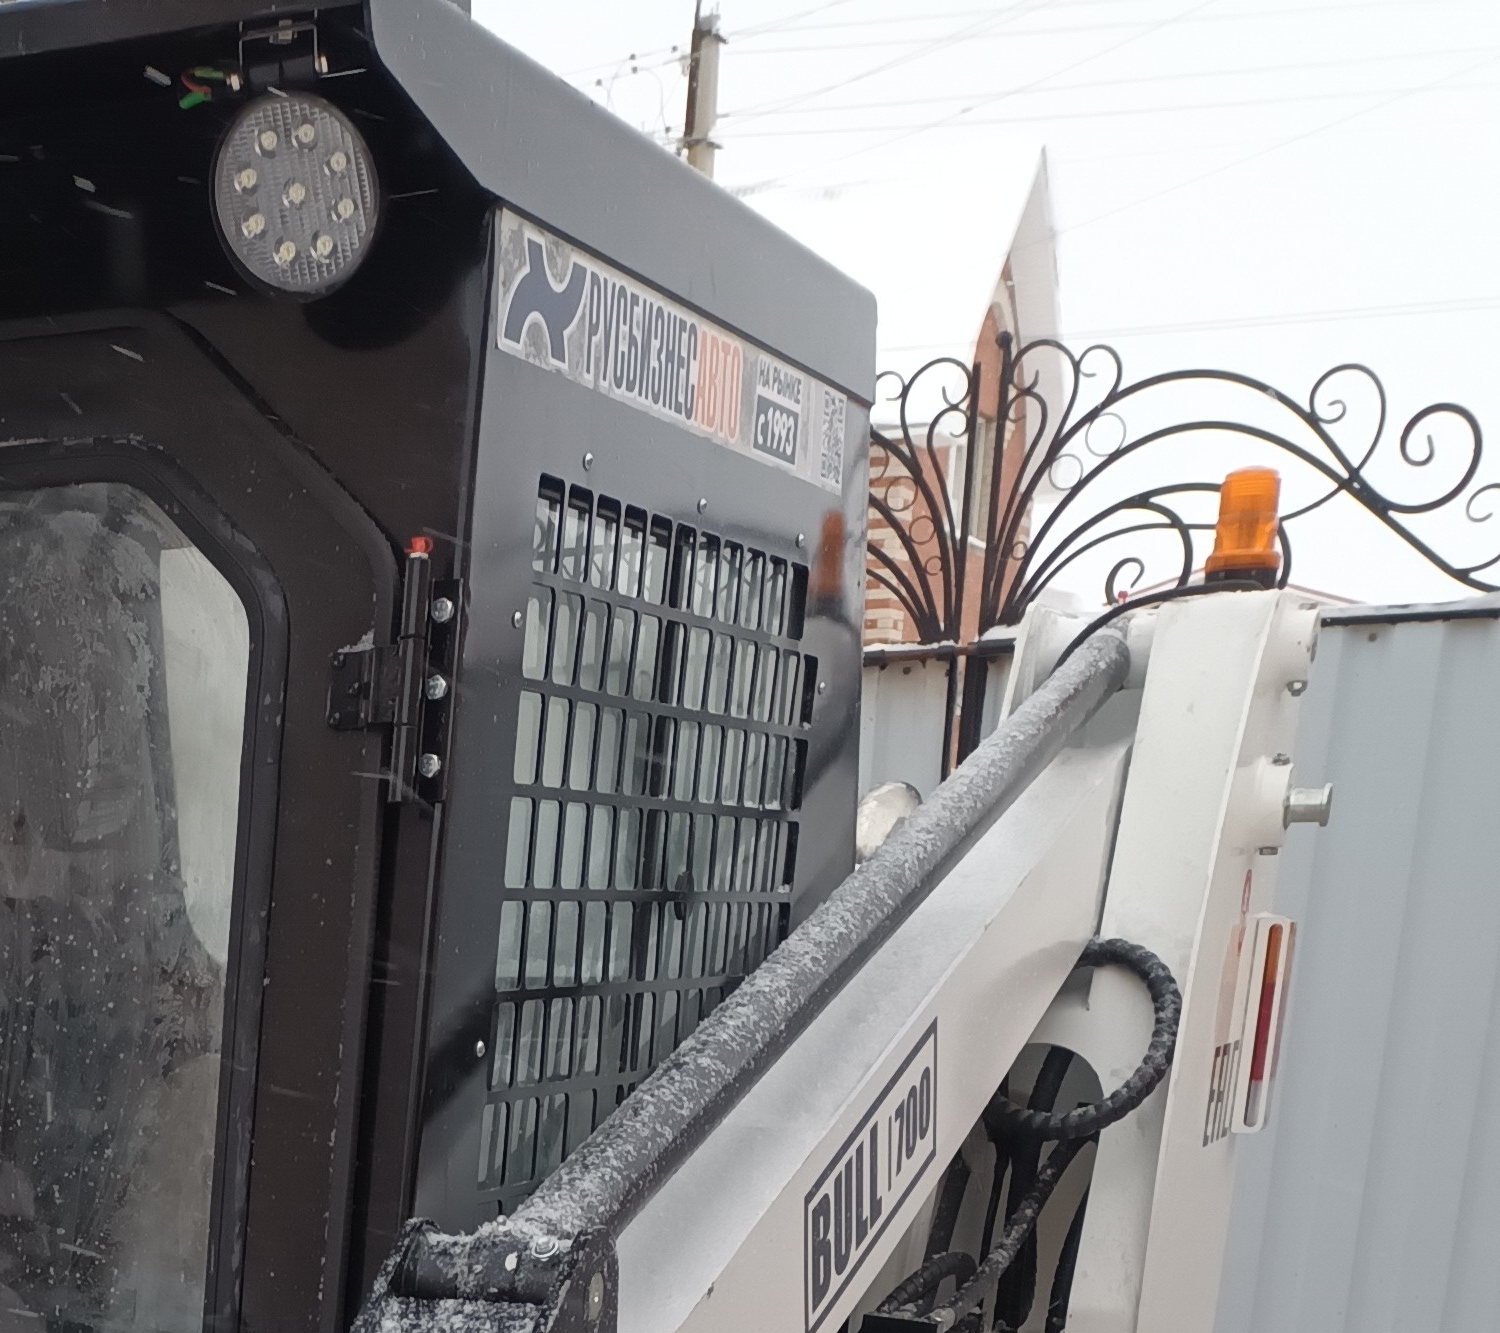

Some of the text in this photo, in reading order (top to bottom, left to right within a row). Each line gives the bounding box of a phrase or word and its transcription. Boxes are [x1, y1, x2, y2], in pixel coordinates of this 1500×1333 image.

[585, 270, 743, 440] РУСБИЗНЕСАВТО
[757, 358, 803, 405] НА РЫНКЕ
[811, 1065, 932, 1315] BULL 700
